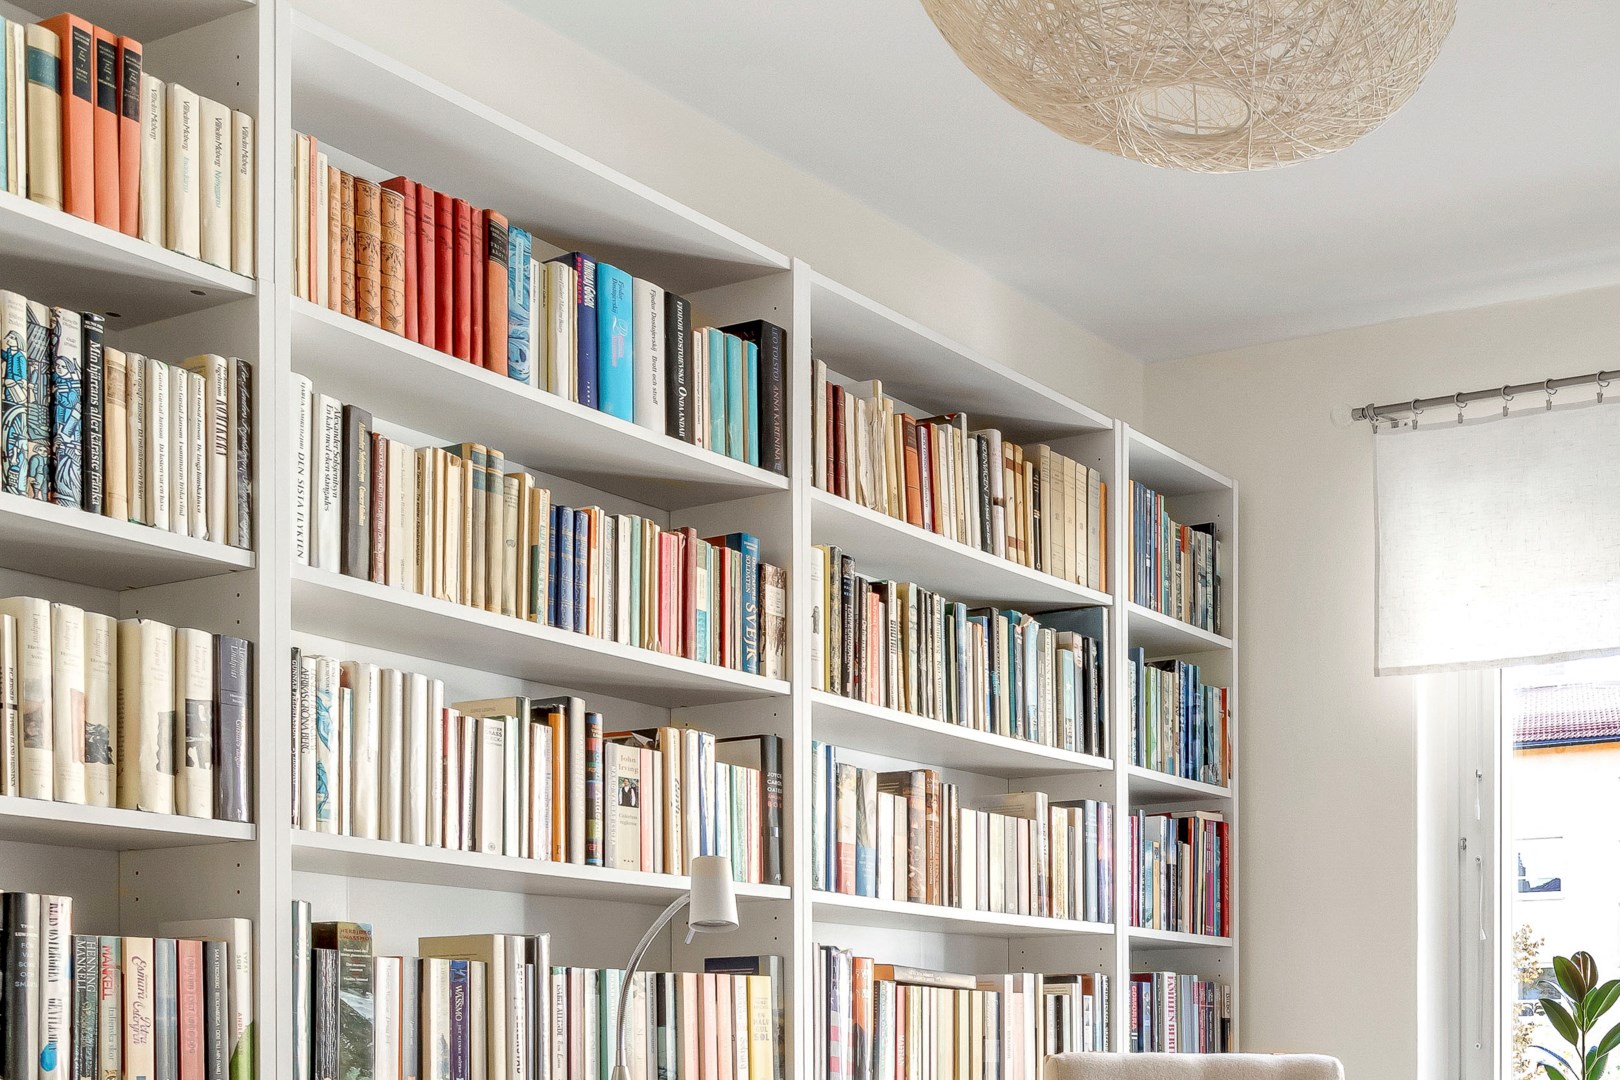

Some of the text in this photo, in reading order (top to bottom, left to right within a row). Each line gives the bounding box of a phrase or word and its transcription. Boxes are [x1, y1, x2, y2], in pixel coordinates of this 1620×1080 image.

[150, 89, 158, 140] Vilhelm Moberg
[182, 101, 190, 124] Vilhelm
[214, 117, 222, 141] Vilhelm
[182, 125, 190, 151] Moberg
[214, 141, 222, 168] Moberg
[241, 126, 249, 175] Vilhelm Moberg
[676, 301, 684, 330] FJODOR
[90, 340, 101, 363] Min
[772, 346, 780, 382] TOLSTOJ
[87, 365, 101, 405] hjärtans
[90, 407, 101, 431] aller
[326, 404, 333, 415] En
[90, 432, 101, 470] käraste
[332, 407, 341, 499] Alexander Solsjenitsyn
[90, 471, 101, 505] fränka
[744, 602, 759, 661] ŠVEJK
[230, 645, 238, 679] Lindqvist
[301, 667, 311, 754] AFRIKAS GRÖNA BERG
[618, 764, 639, 774] Irving
[620, 755, 637, 764] John
[76, 940, 86, 992] MANKELL
[87, 941, 96, 992] HENNING
[102, 945, 113, 1001] MANKELL
[132, 956, 147, 1000] Esmara
[108, 1007, 117, 1043] Italienska
